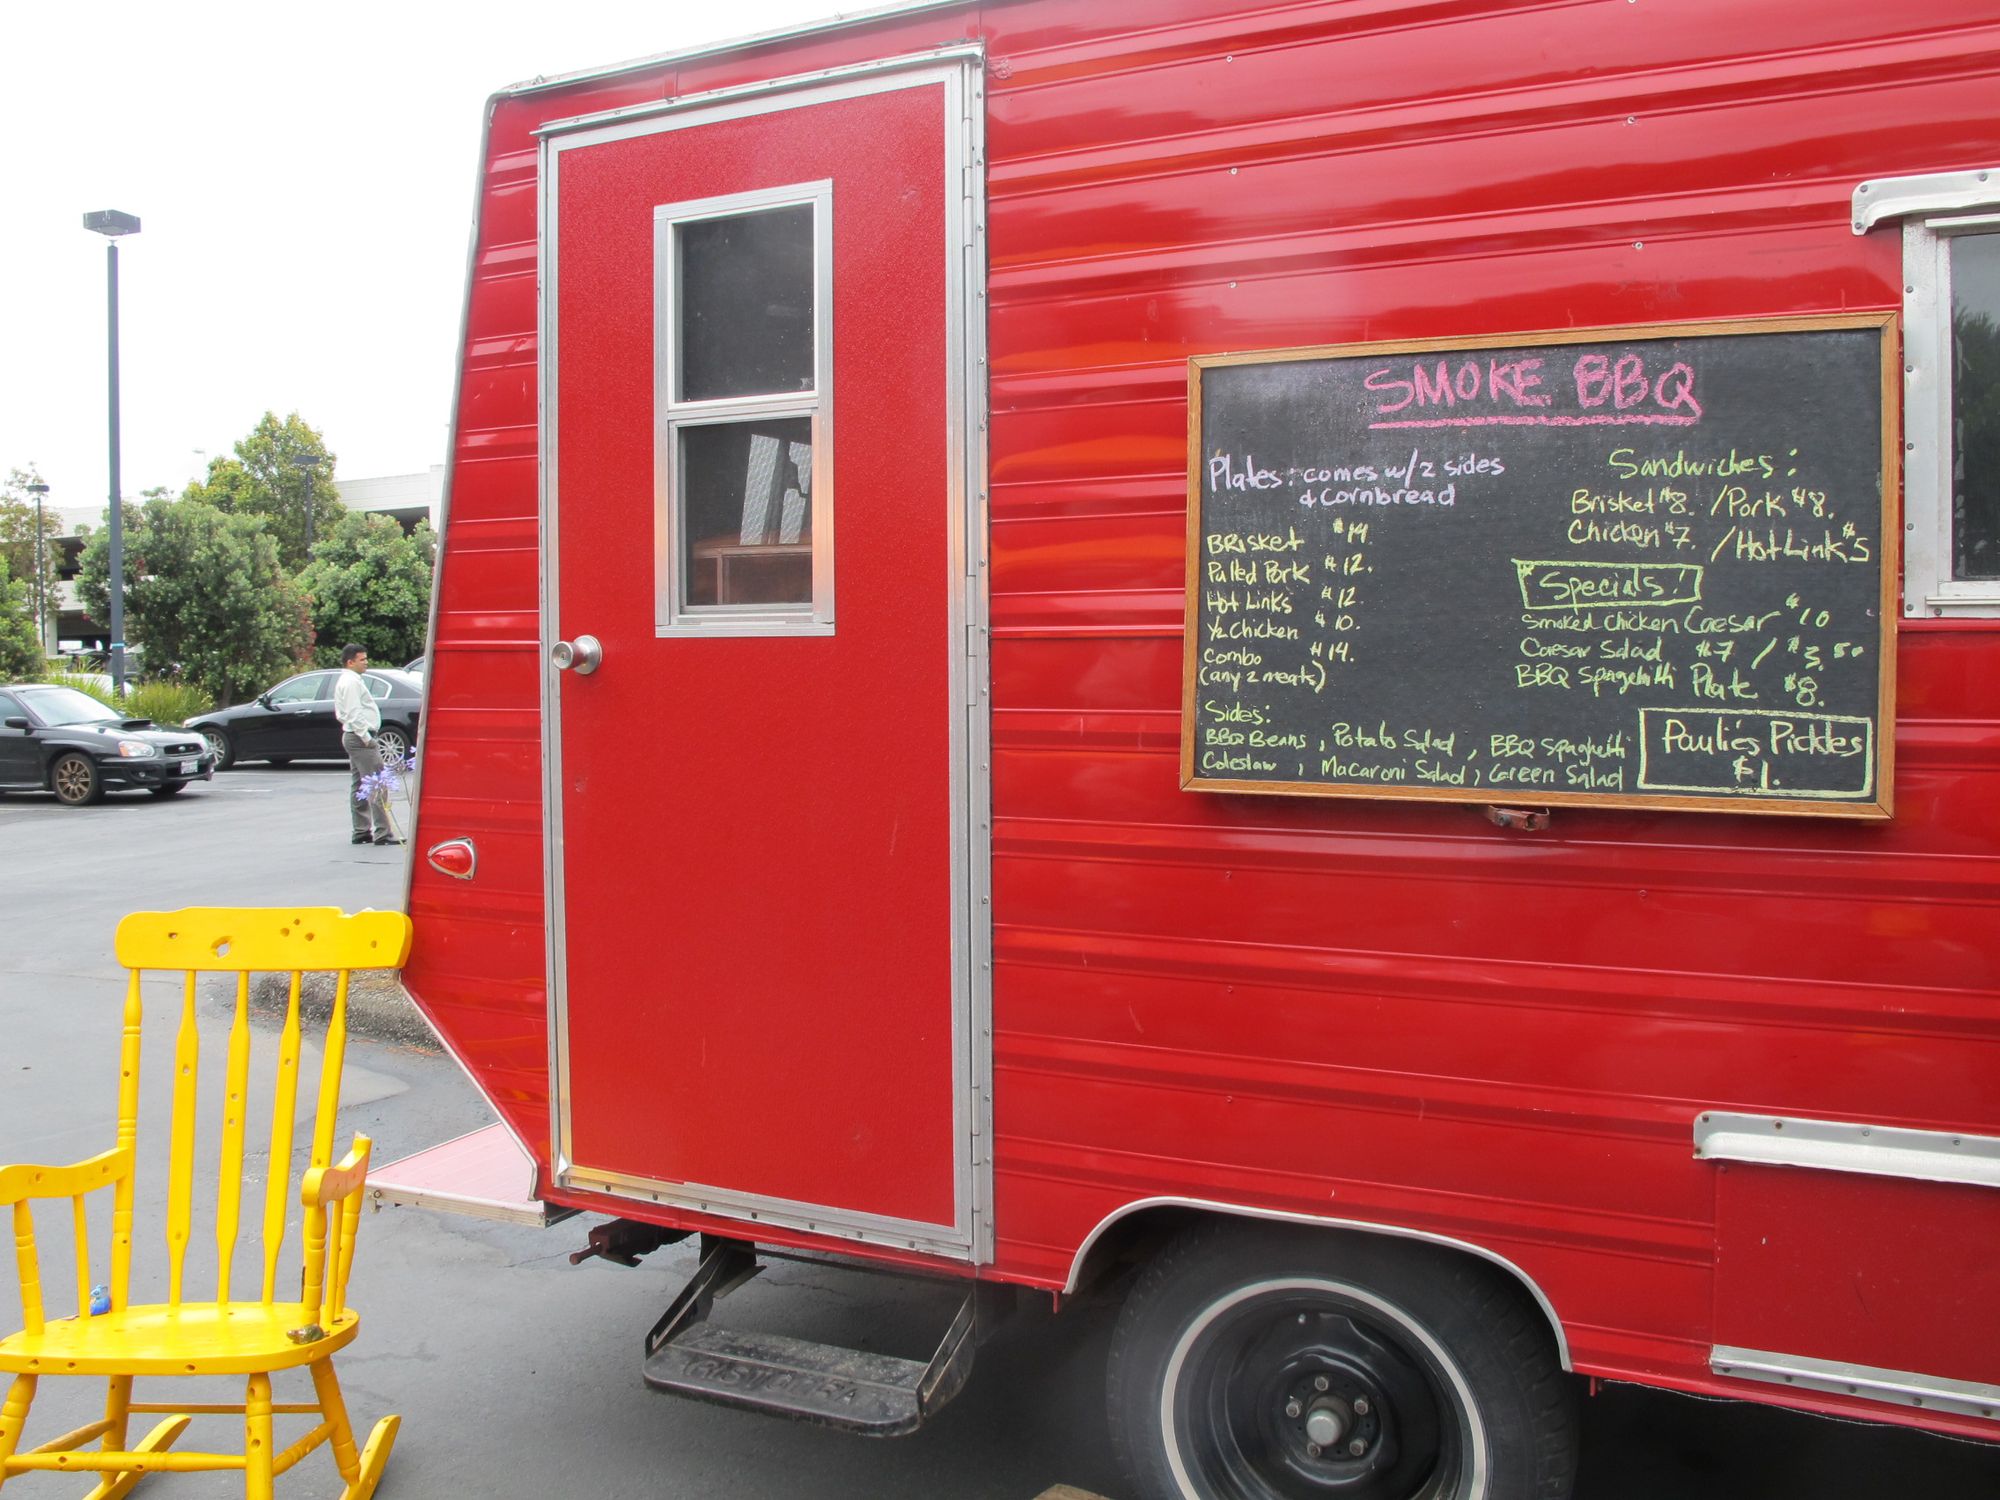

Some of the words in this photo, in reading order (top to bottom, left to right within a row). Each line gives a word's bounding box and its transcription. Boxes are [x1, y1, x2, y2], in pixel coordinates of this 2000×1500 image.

[1363, 358, 1552, 413] SMOKE
[1572, 353, 1703, 416] BBQ
[1303, 465, 1378, 482] comes
[1444, 453, 1505, 475] sides
[1571, 488, 1655, 515] Brisket
[1567, 519, 1661, 548] Chicken
[1207, 557, 1258, 586] Pulled
[1264, 558, 1311, 584] Pork
[1207, 591, 1239, 614] Hot
[1245, 589, 1293, 614] Links
[1229, 617, 1300, 640] Chicken
[1683, 605, 1782, 634] Caesar
[1519, 636, 1592, 659] Caesar
[1599, 635, 1663, 663] Salad
[1246, 671, 1261, 683] 2
[1514, 662, 1571, 690] BBQ
[1204, 699, 1271, 725] Sides:
[1205, 727, 1246, 747] BBQ
[1331, 719, 1397, 750] Potato
[1490, 734, 1535, 758] BBQ
[1321, 755, 1406, 781] Macaroni
[1566, 764, 1623, 792] Salad
